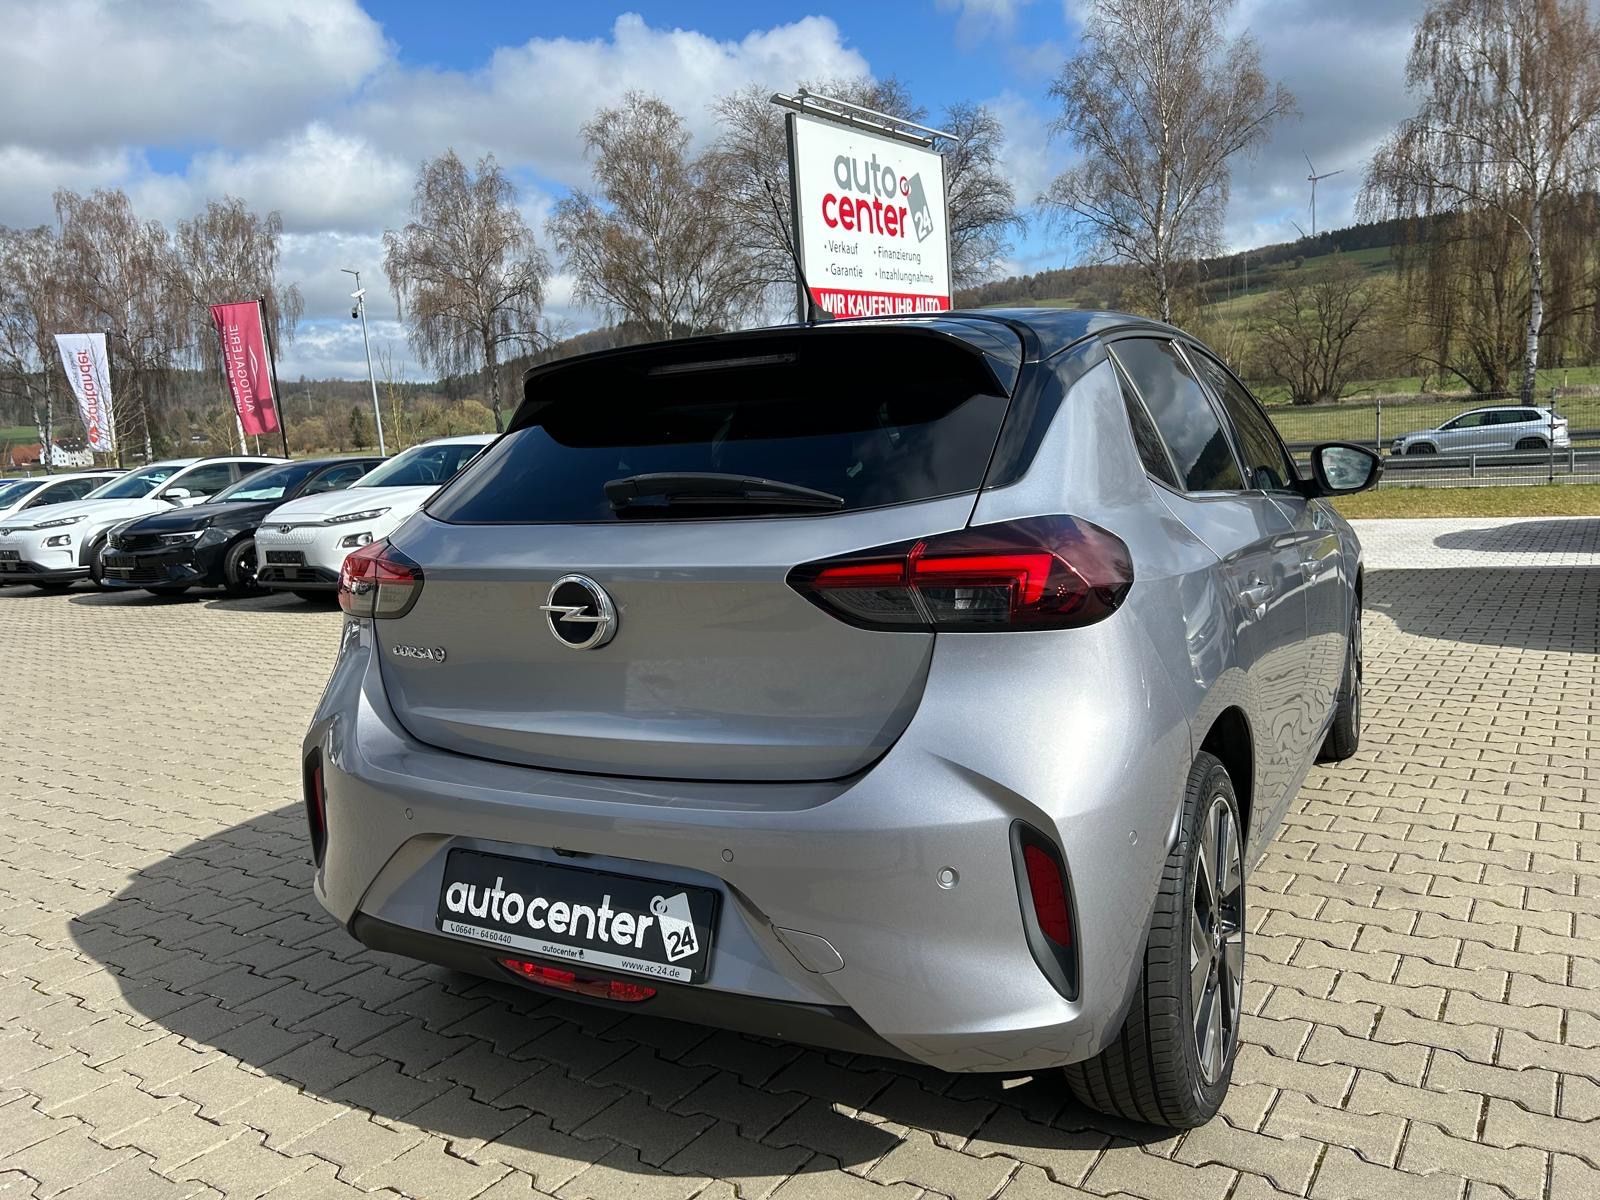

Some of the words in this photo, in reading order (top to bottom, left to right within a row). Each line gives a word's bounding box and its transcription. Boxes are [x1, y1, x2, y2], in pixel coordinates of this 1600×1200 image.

[833, 152, 897, 199] auto
[822, 193, 908, 238] center
[914, 209, 933, 238] 24
[828, 240, 859, 256] Verkauf
[878, 246, 921, 264] Finanzierung
[830, 263, 864, 279] Garantie
[879, 267, 934, 285] Inzahlungnahme
[820, 292, 846, 314] WIR
[847, 294, 893, 316] KAUFEN
[895, 296, 913, 314] IHR
[915, 297, 941, 312] AUTO
[542, 945, 578, 958] autocenter
[666, 927, 695, 958] 24
[621, 959, 681, 978] www.ac-24.de
